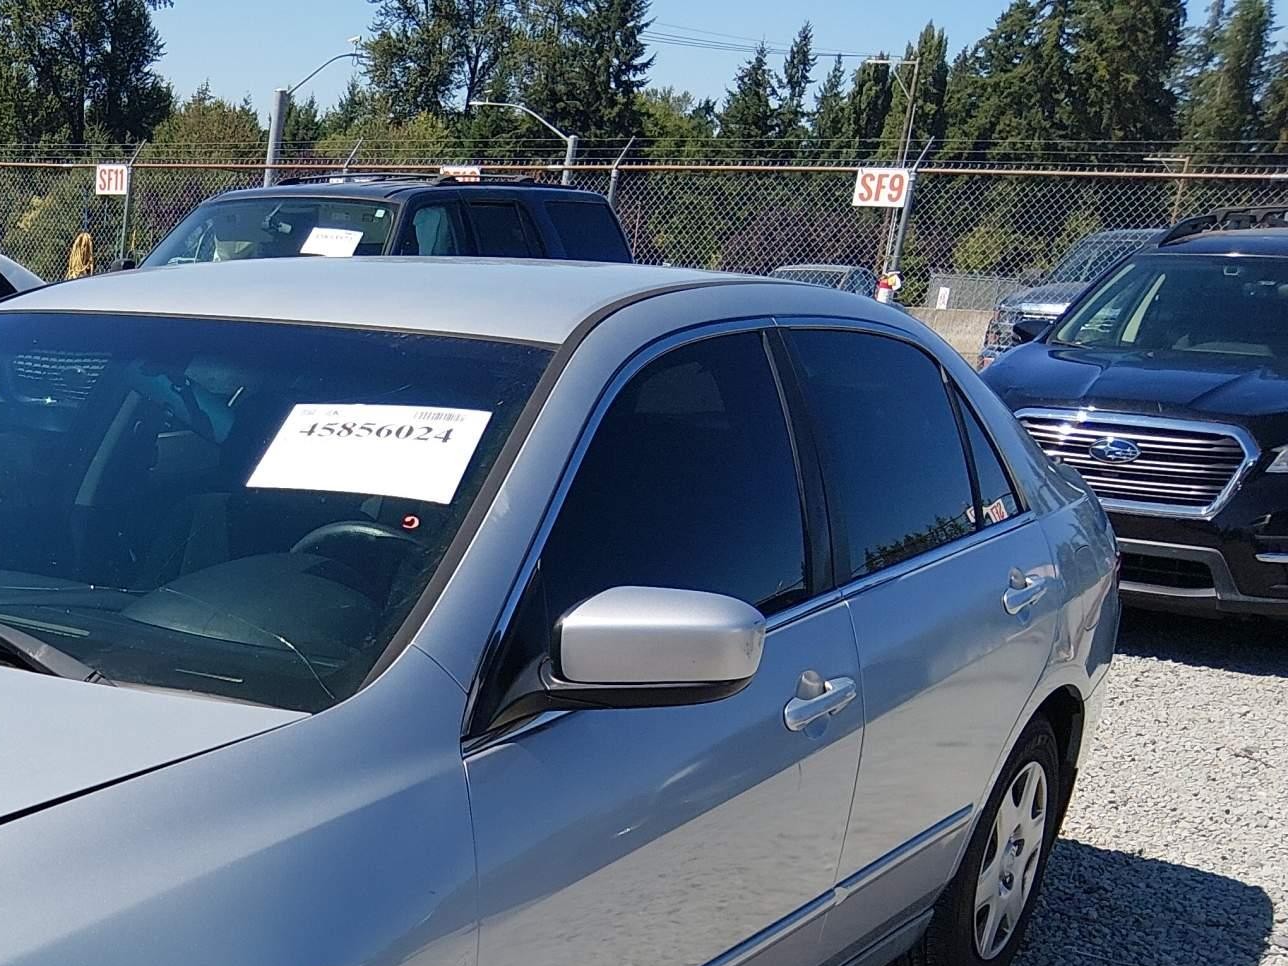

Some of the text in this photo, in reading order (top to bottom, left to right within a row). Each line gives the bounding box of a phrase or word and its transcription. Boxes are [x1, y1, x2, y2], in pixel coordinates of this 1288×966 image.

[99, 168, 124, 191] SF11
[858, 173, 904, 202] SF9
[298, 421, 454, 443] 45856024
